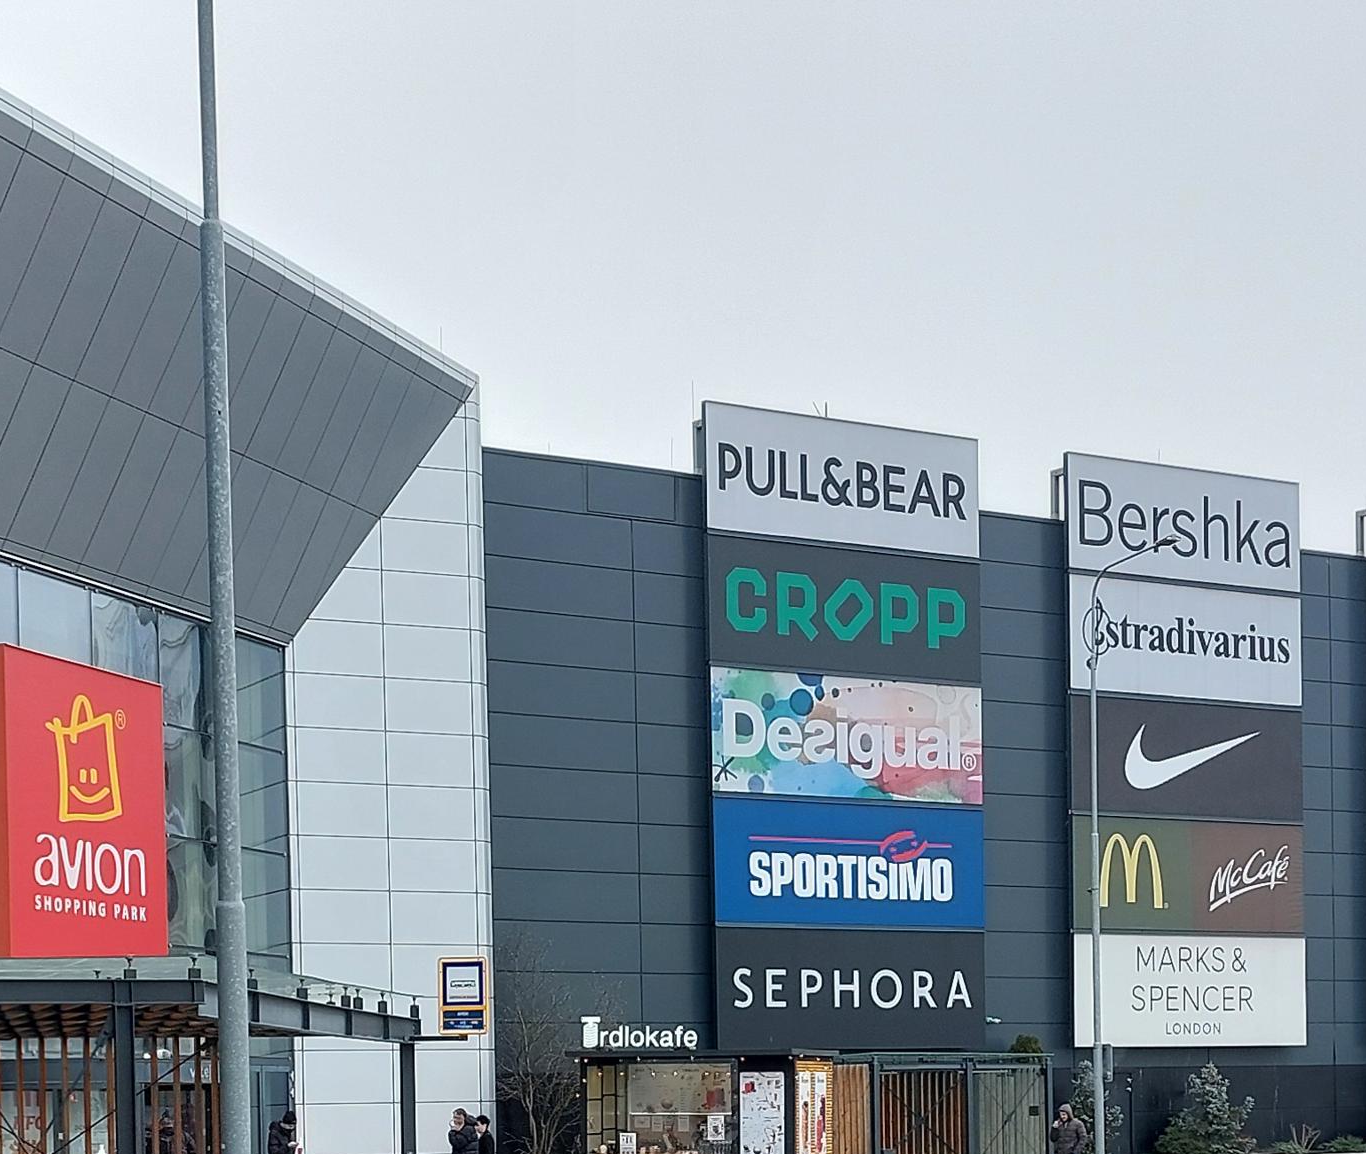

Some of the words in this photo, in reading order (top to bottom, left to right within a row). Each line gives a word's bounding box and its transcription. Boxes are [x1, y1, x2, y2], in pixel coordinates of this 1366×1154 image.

[718, 442, 967, 520] PULL&BEAR
[1077, 479, 1292, 569] Bershka
[725, 566, 968, 648] CROPP
[722, 700, 961, 780] Desigual
[33, 832, 147, 896] avion
[749, 851, 954, 902] SPORTISIMO
[1209, 844, 1290, 912] McCafé
[34, 894, 107, 917] SHOPPING
[113, 902, 147, 922] PARK
[734, 967, 972, 1009] SEPHORA
[1136, 946, 1226, 974] MARKS
[1232, 947, 1248, 973] &
[1132, 985, 1254, 1012] SPENCER
[1165, 1022, 1222, 1035] LONDON
